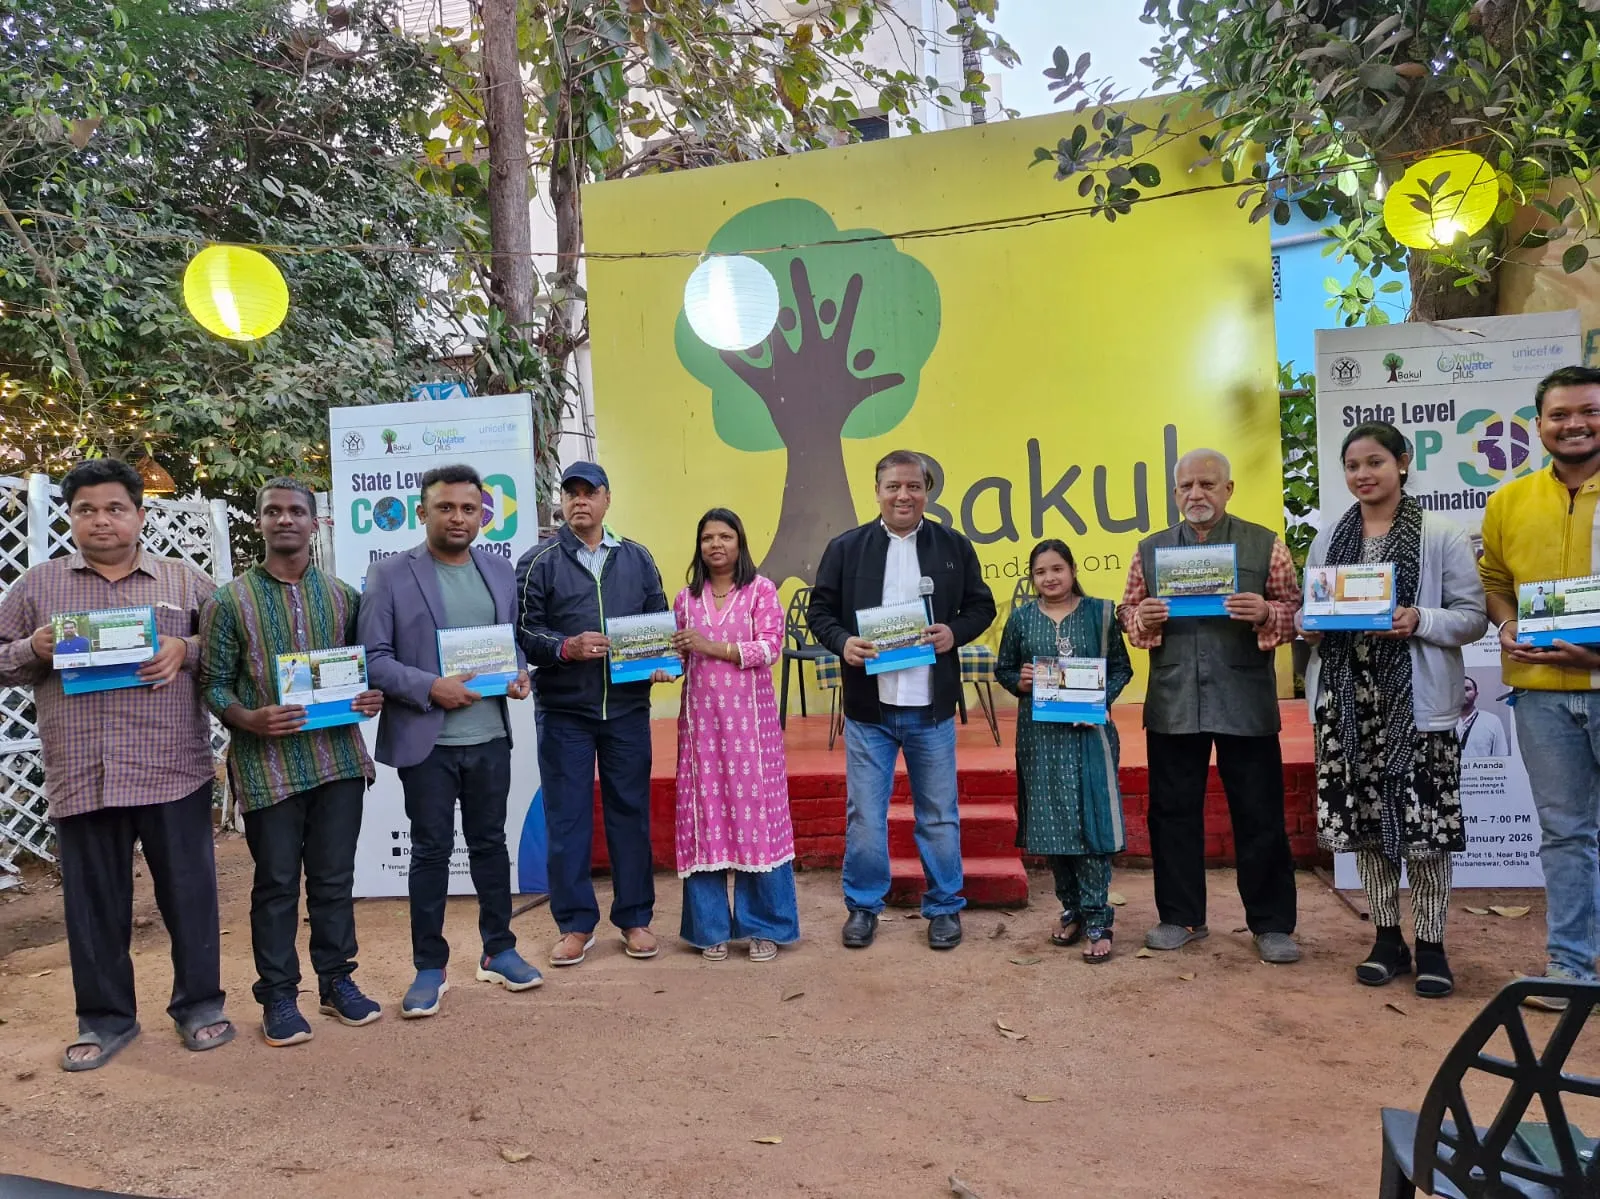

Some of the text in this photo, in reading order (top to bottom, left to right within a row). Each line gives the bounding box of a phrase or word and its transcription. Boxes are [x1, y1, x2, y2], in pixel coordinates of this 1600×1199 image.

[1512, 345, 1550, 358] unicef
[1453, 352, 1485, 364] Youth
[1398, 370, 1421, 380] Bakul
[1453, 370, 1474, 384] plus
[1343, 400, 1455, 427] State Level
[393, 443, 411, 451] Bakul
[435, 443, 451, 454] plus
[352, 470, 423, 492] State Lev
[1416, 488, 1495, 511] minatio
[1179, 559, 1211, 567] 2026
[1171, 567, 1219, 576] CALENDAR
[873, 622, 915, 634] CALENDAR
[622, 633, 664, 642] CALENDAR
[456, 646, 502, 656] CALENDAR
[1490, 815, 1511, 824] 7:00
[1514, 815, 1531, 823] PM
[1465, 833, 1533, 844] January 2026
[1515, 851, 1528, 859] Big
